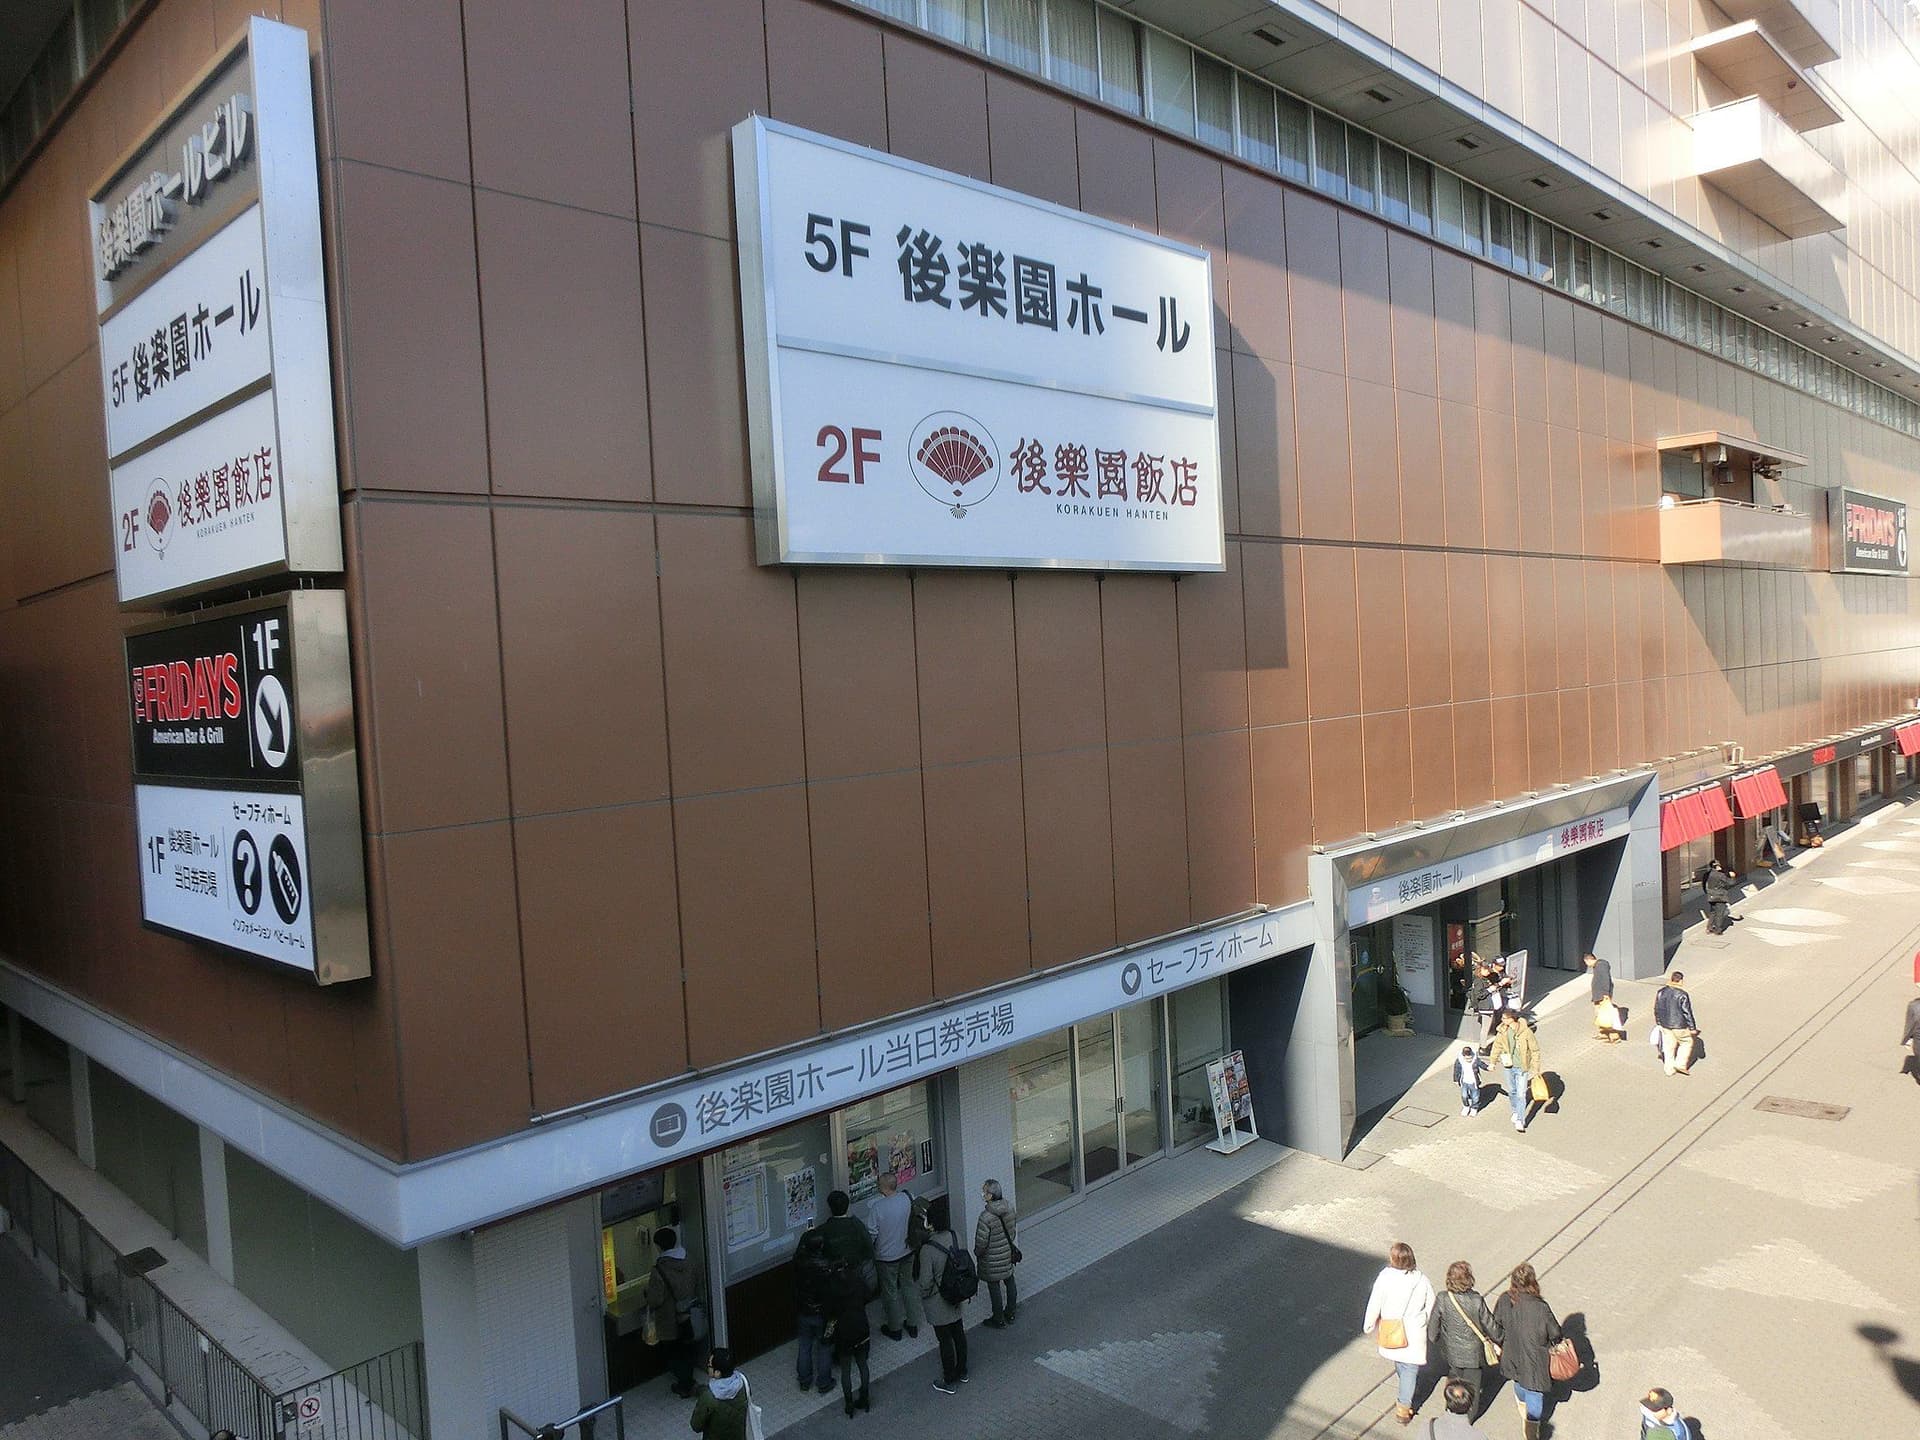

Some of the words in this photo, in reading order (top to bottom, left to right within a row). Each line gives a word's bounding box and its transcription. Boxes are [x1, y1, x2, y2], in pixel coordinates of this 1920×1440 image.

[99, 94, 248, 279] 後楽園ホールビル
[804, 212, 871, 278] 5F
[896, 224, 1192, 354] 後楽園ホール
[112, 361, 129, 408] 5F
[133, 268, 261, 403] 後楽園ホール
[816, 424, 882, 485] 2F
[1009, 436, 1199, 507] 後樂園飯店
[121, 508, 140, 552] 2F
[177, 445, 273, 529] 後樂園飯店
[1056, 503, 1119, 518] KORAKUEN
[1126, 507, 1169, 522] HANTEN
[1852, 504, 1895, 547] FRIDAYS
[252, 619, 279, 670] 1F
[143, 652, 242, 723] FRIDAYS
[152, 728, 185, 744] American
[184, 728, 199, 744] Bar
[199, 727, 207, 744] &
[206, 726, 224, 744] Grill
[232, 801, 292, 825] セーフティホーム
[148, 836, 165, 875] 1F
[1398, 864, 1463, 904] 後楽園ホール
[1147, 923, 1273, 984] セーフティホーム
[695, 1002, 1014, 1136] 後楽園ホール当日券売場
